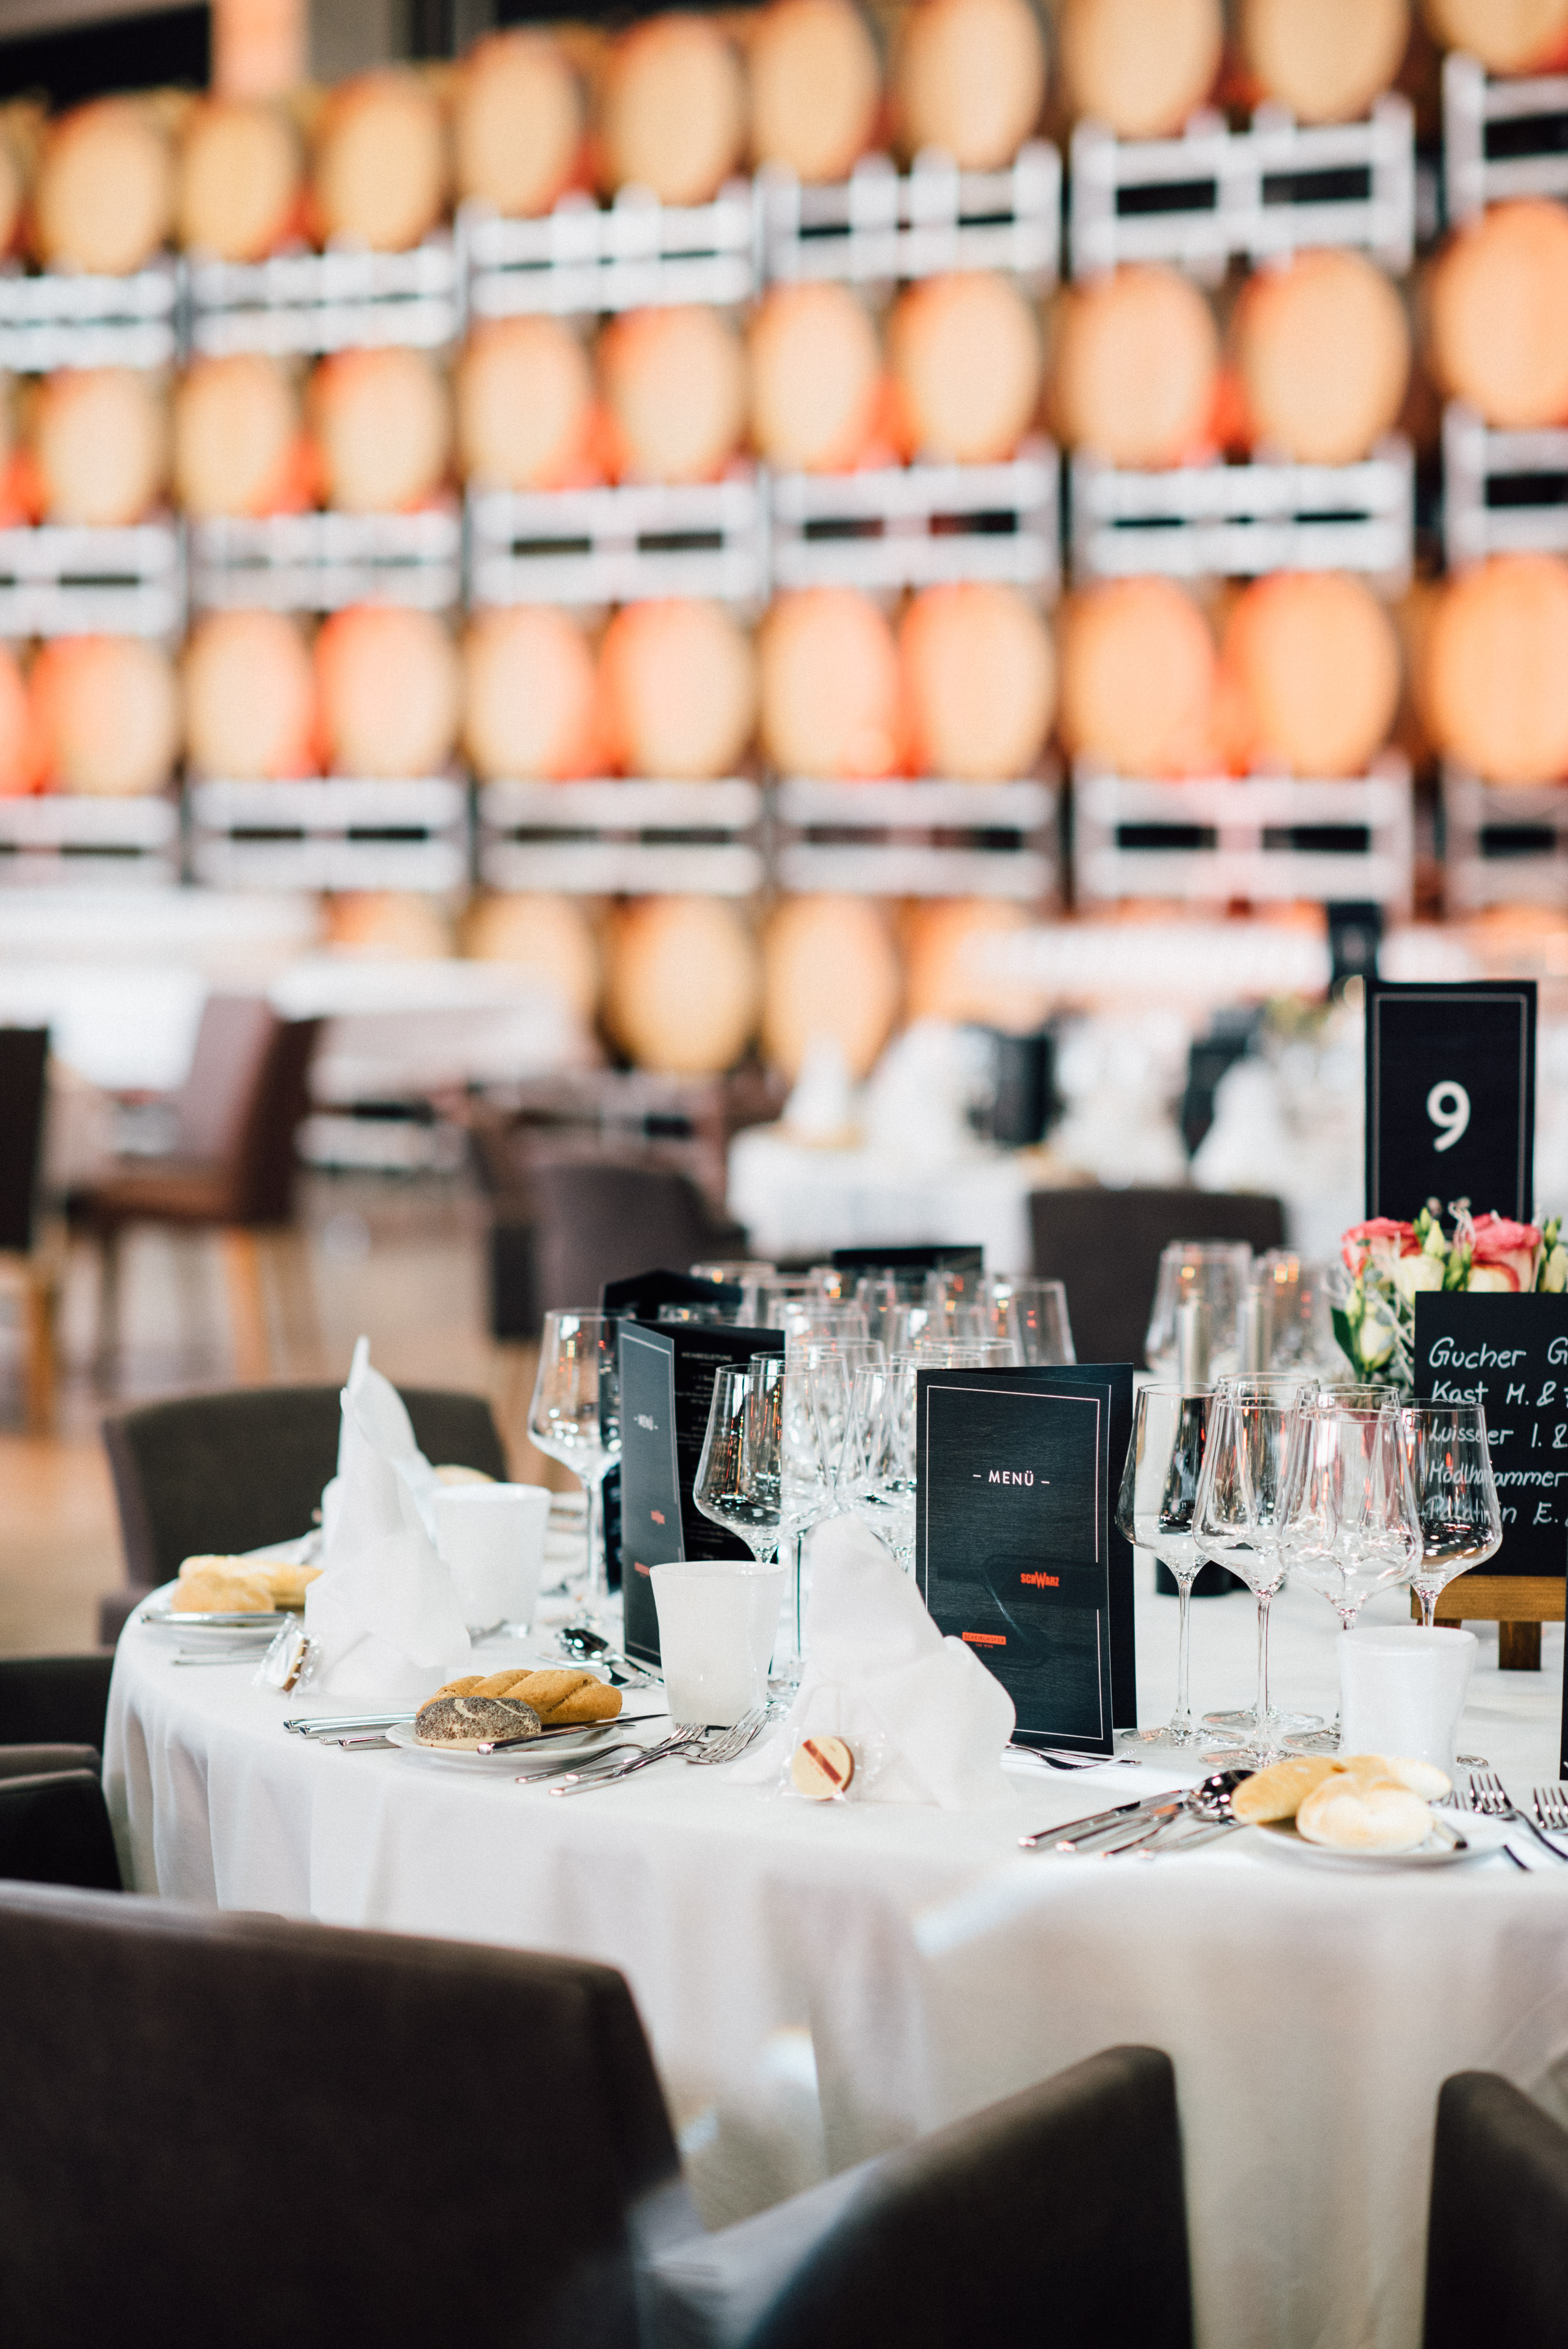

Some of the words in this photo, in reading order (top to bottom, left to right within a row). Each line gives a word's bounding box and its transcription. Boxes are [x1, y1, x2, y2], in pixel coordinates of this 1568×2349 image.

[1426, 1080, 1471, 1152] 9
[1429, 1337, 1526, 1369] Gucher
[1431, 1380, 1489, 1404] Kast
[1536, 1381, 1557, 1407] &
[988, 1470, 1034, 1486] MENÜ
[1021, 1571, 1059, 1589] SCHWARZ
